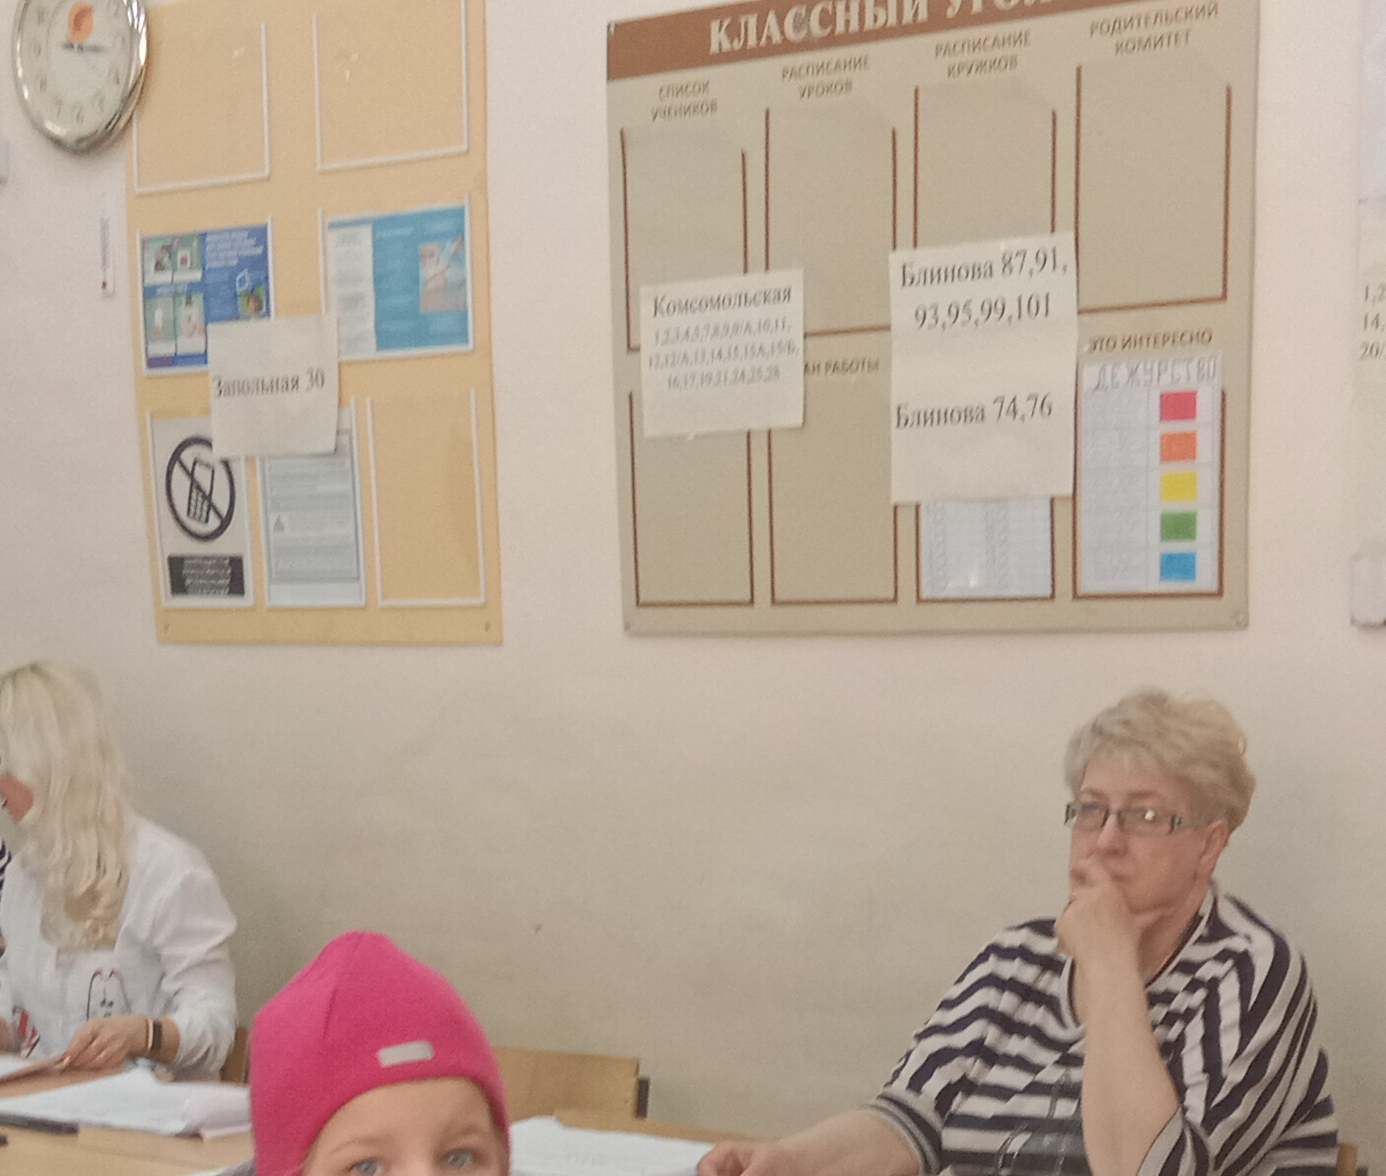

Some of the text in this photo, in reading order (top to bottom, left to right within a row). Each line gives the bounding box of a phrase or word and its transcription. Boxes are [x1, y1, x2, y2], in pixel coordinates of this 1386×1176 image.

[709, 0, 929, 54] КЛАССНЫЙ
[1090, 2, 1219, 37] РОДИТЕЛЬСКИЙ
[934, 29, 1031, 58] РАСПИСАНИЕ
[1115, 28, 1191, 56] КОМИТЕТ
[781, 54, 869, 80] РАСПИСАНИЕ
[947, 54, 1018, 78] КРУЖКОВ
[658, 80, 710, 101] СПИСОК
[799, 79, 853, 99] УРОКОВ
[651, 99, 717, 121] УЧЕНИКОВ
[901, 247, 1068, 288] Блинова 87,91,
[653, 285, 792, 318] Комсомольская
[914, 292, 1050, 333] 93,95,99,101
[1121, 328, 1213, 351] ИНТЕРЕСНО
[824, 357, 880, 376] РАБОТЫ
[1094, 355, 1216, 392] ДЕЖУРСТВО
[213, 366, 325, 399] Запольная 30
[896, 391, 1053, 429] Блинова 74,76
